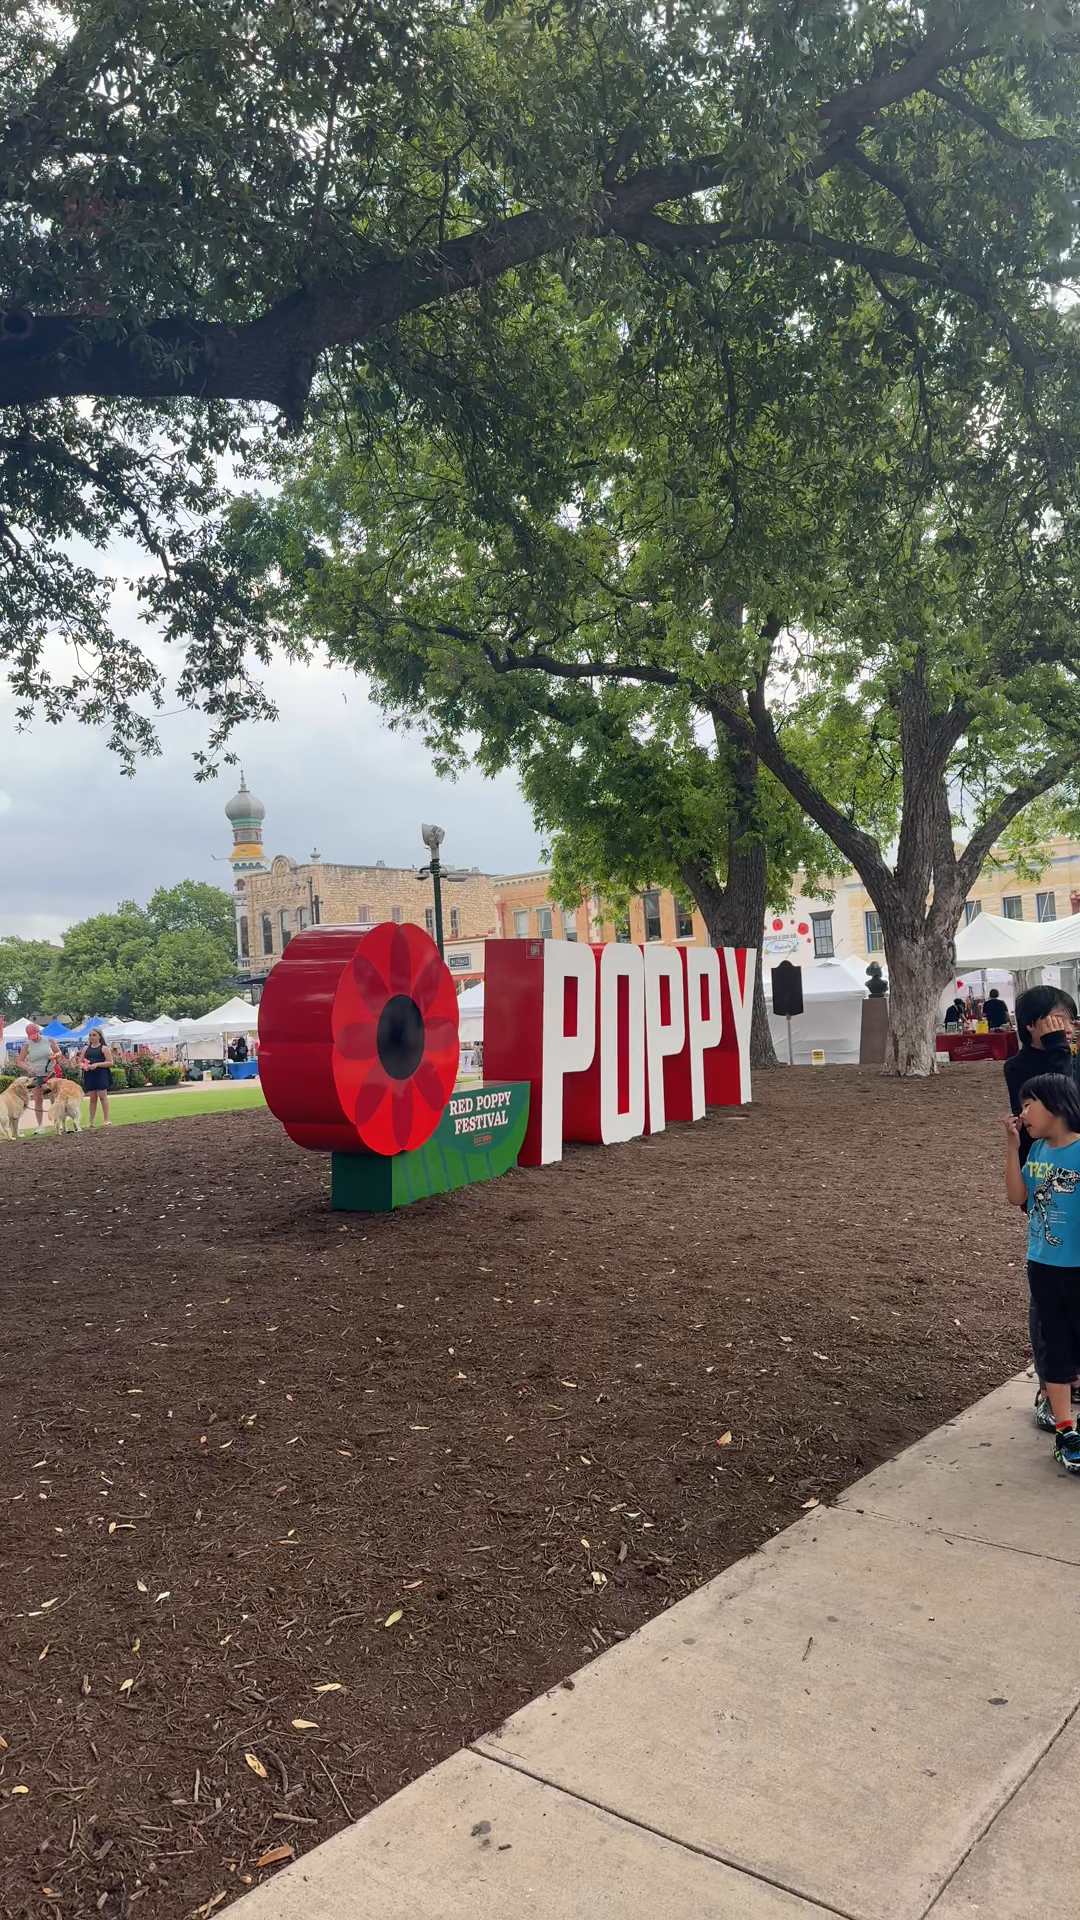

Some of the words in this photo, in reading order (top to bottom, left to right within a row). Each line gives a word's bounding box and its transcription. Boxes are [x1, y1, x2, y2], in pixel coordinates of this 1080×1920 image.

[541, 938, 757, 1165] POPPY
[449, 1098, 473, 1116] RED
[476, 1091, 511, 1111] POPPY
[455, 1110, 509, 1135] FESTIVAL
